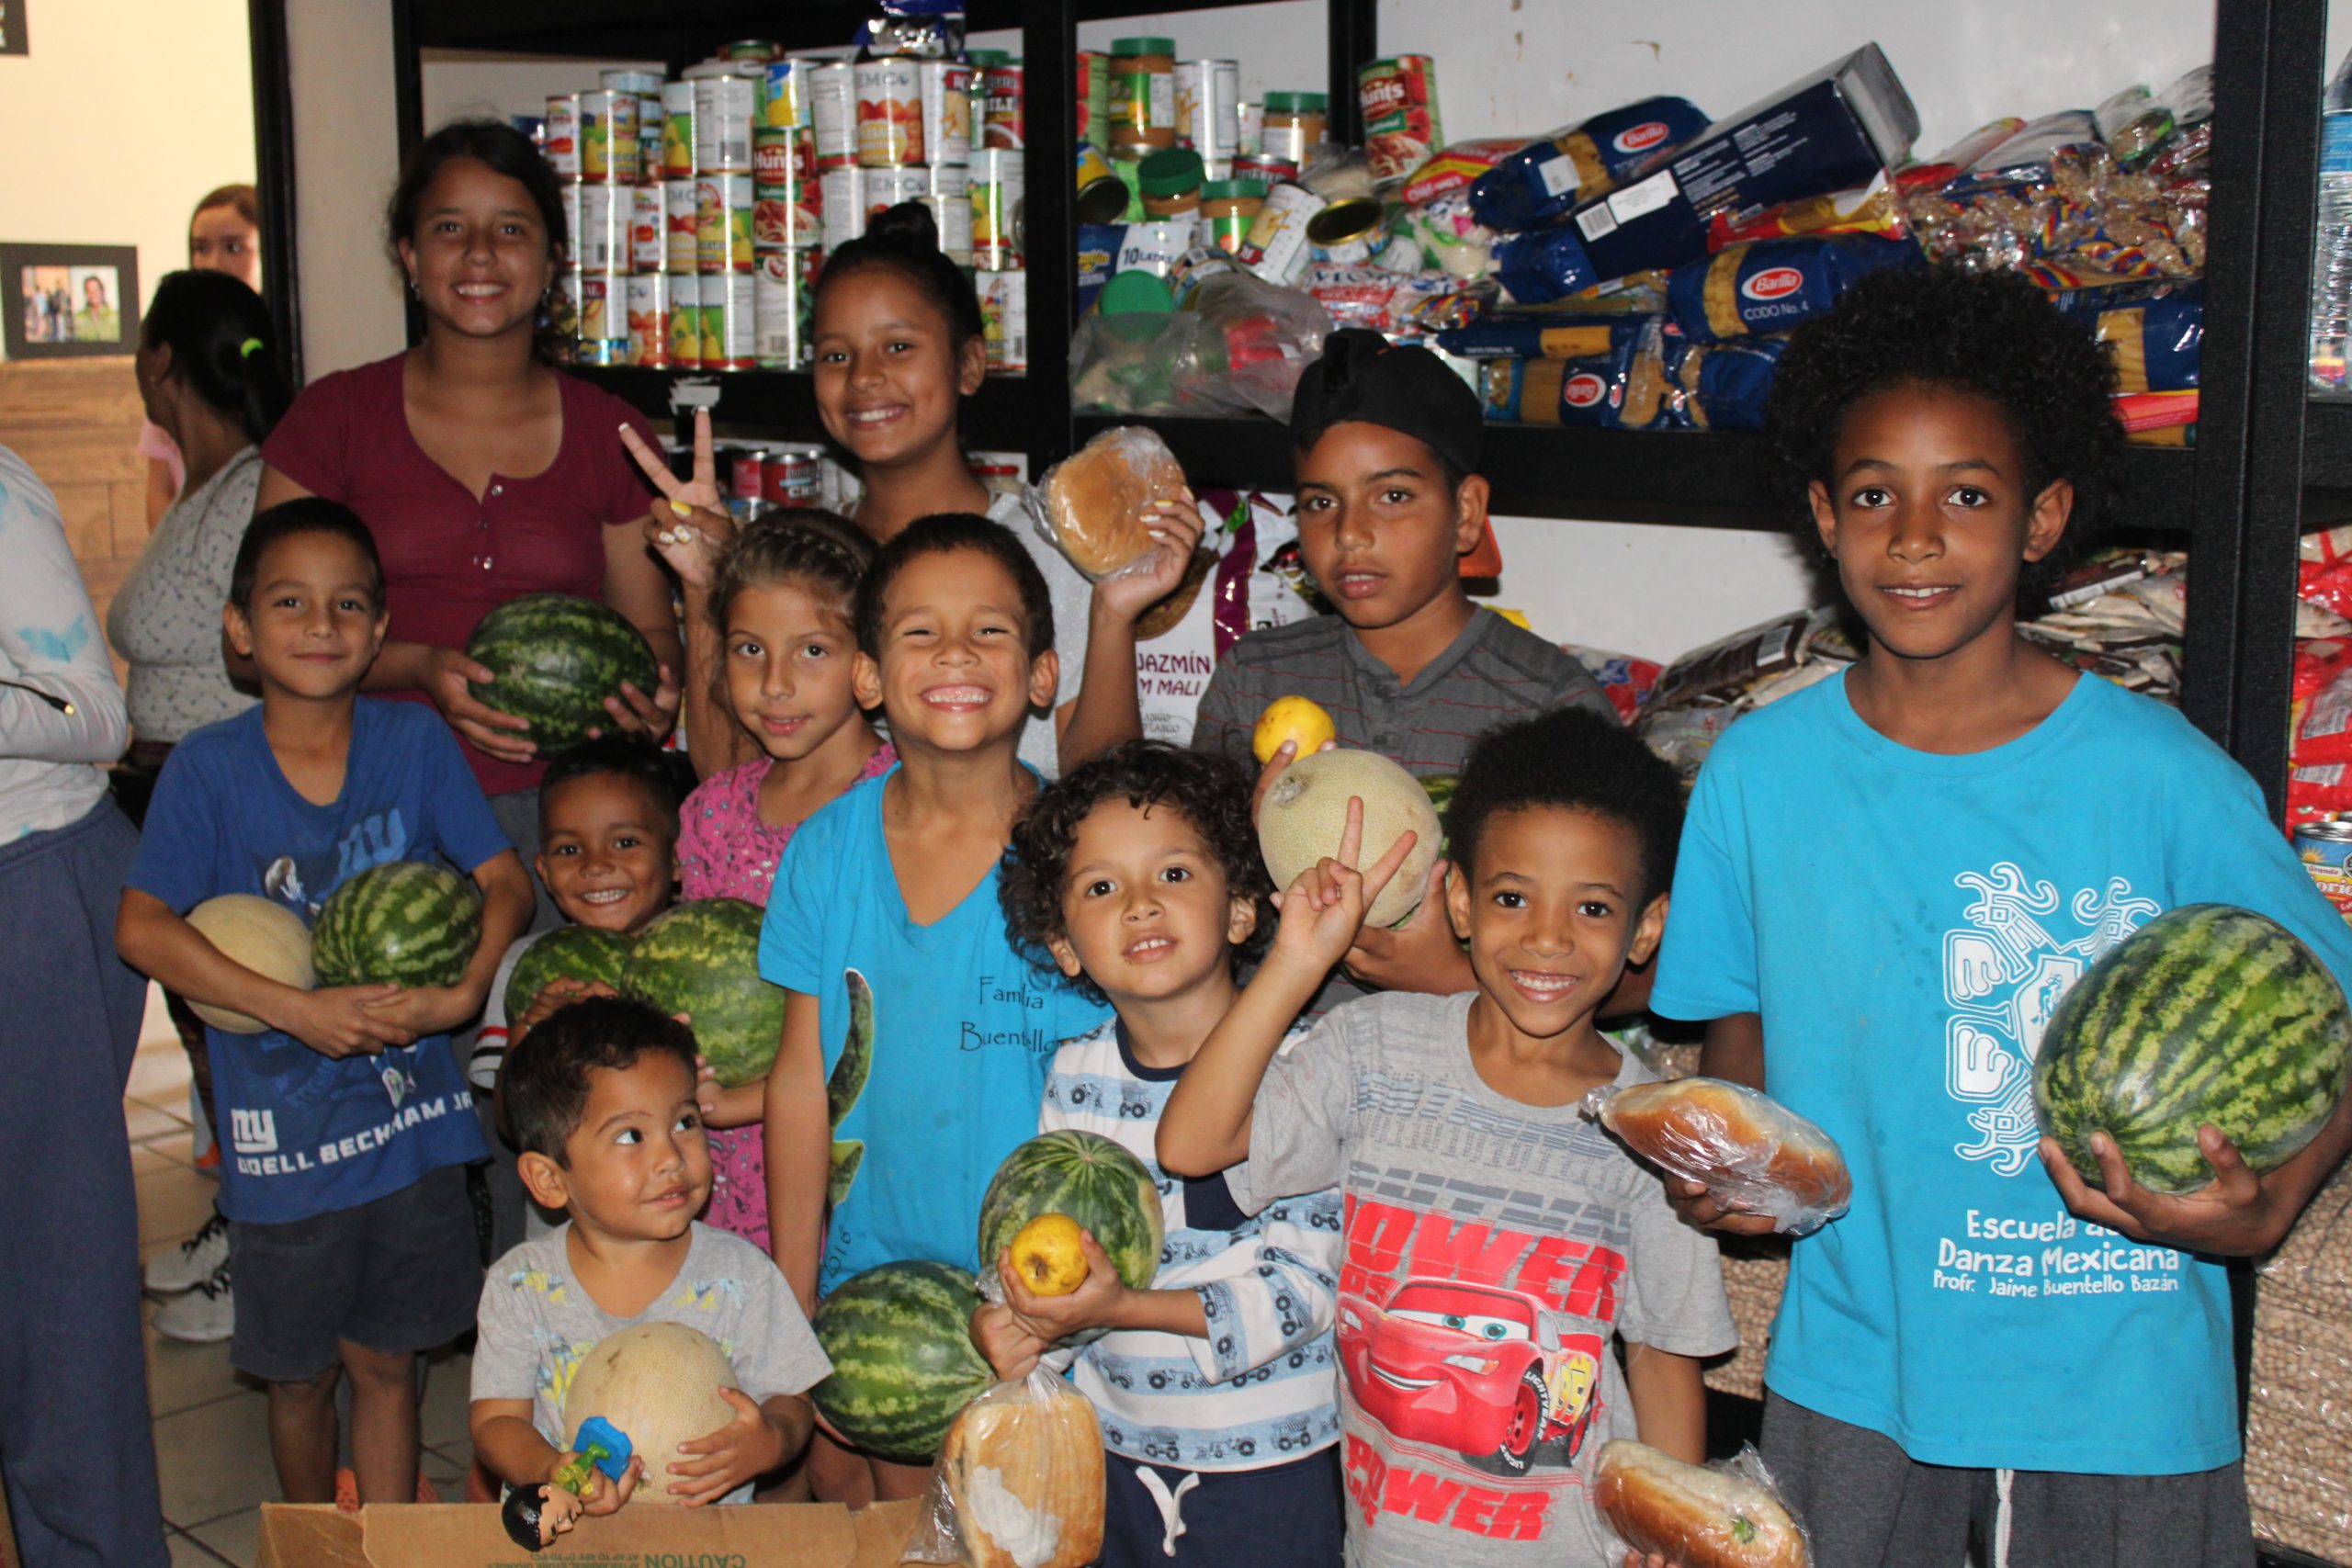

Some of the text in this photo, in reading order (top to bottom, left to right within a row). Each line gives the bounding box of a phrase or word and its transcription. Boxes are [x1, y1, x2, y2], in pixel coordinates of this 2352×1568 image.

[1125, 246, 1139, 265] 10
[1755, 273, 1798, 292] Barilla
[1744, 300, 1809, 321] CODO No. 4
[1136, 649, 1211, 674] JAZMÍN
[1157, 679, 1201, 696] MALI
[2308, 866, 2339, 875] Grande
[978, 976, 1044, 1010] Famlia
[236, 1151, 315, 1177] ODELL
[319, 1097, 447, 1166] BECKHAM
[1966, 1209, 2077, 1242] Escuela
[1343, 1191, 1628, 1324] OWER
[1938, 1237, 2179, 1277] Danza Mexicana
[1933, 1269, 2179, 1298] Profr. Jaime Buentello Bazán
[1345, 1432, 1553, 1540] POWER
[645, 1553, 746, 1568] CAUTION
